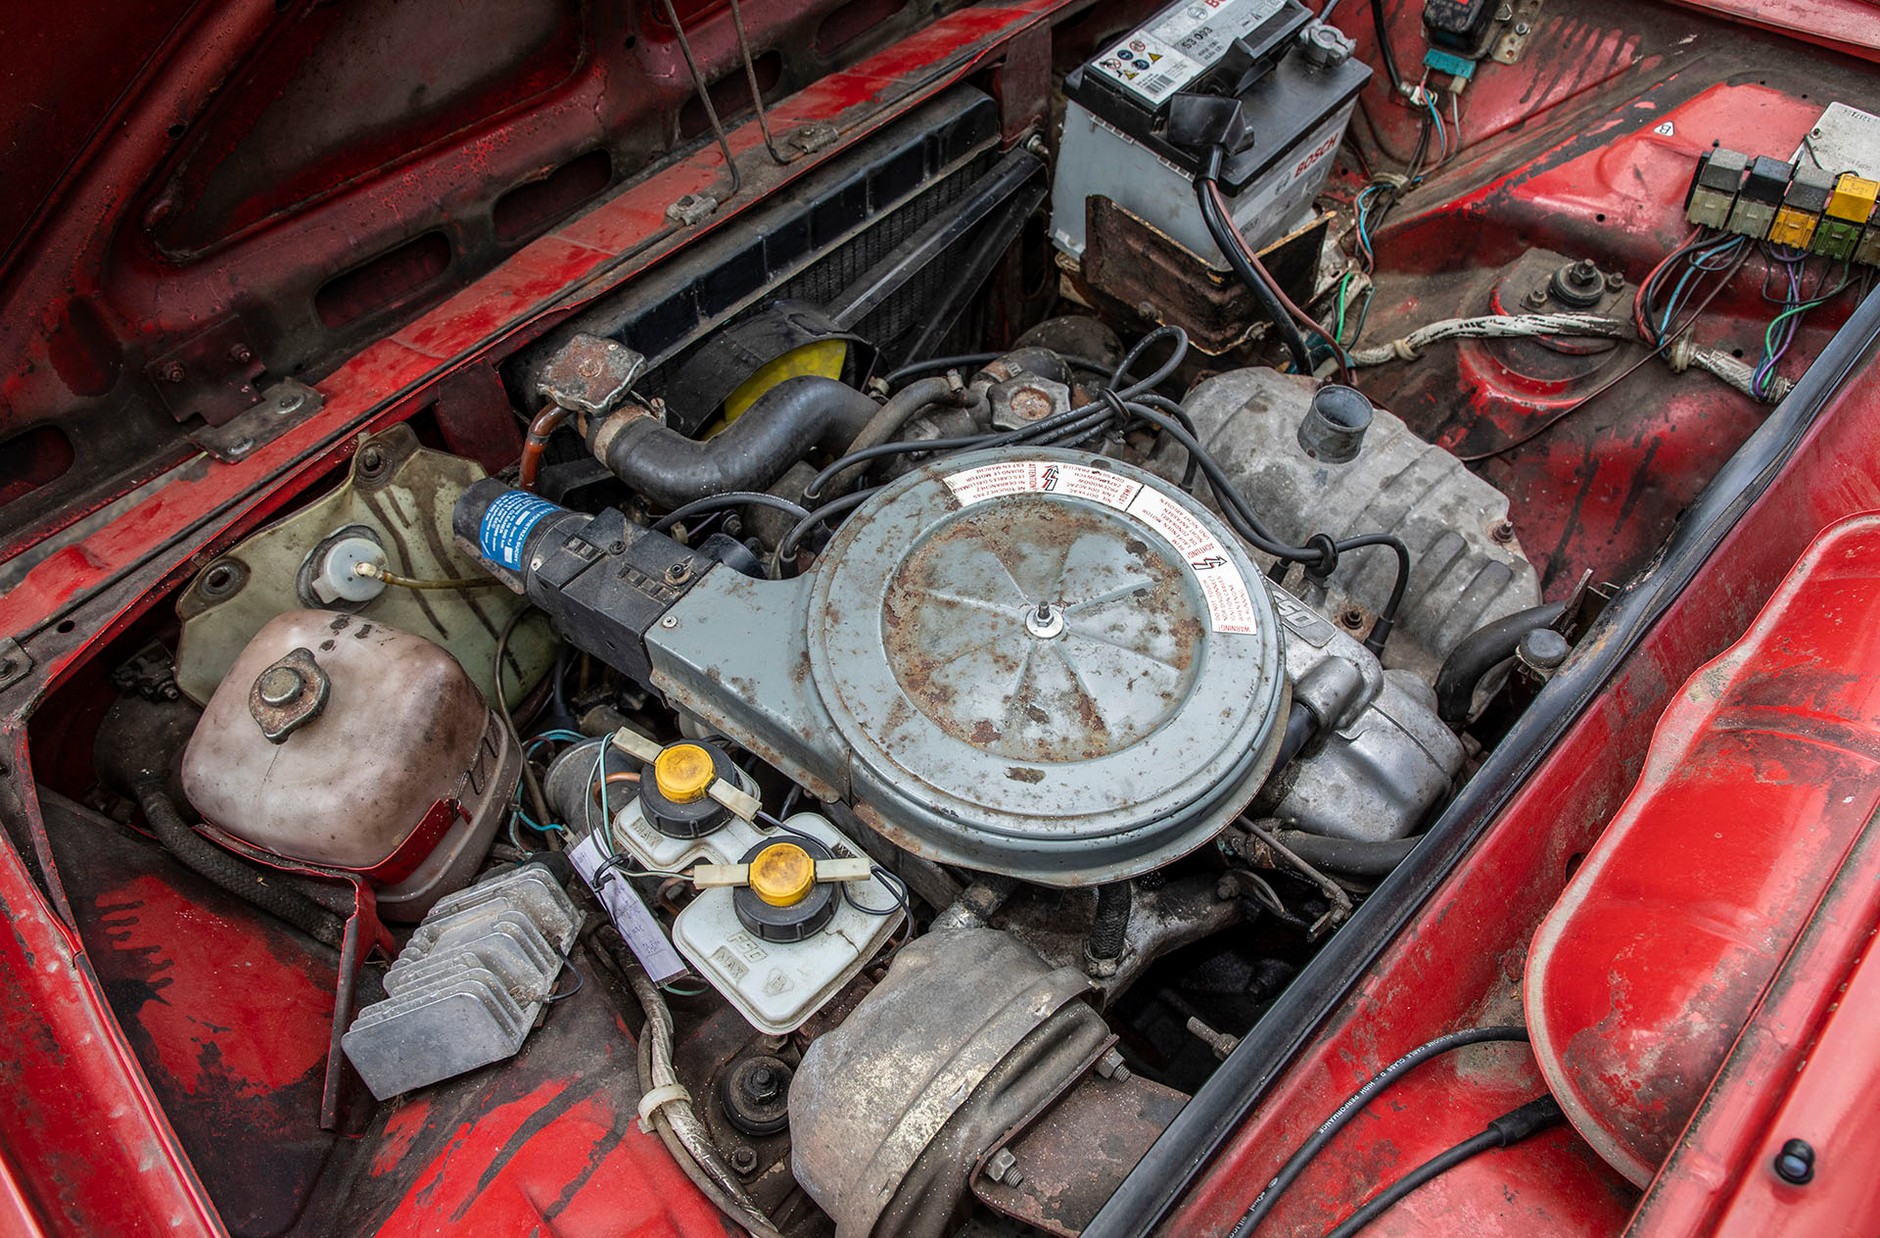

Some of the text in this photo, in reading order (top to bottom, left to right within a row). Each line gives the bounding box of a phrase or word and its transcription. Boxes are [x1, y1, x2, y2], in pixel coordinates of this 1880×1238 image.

[1295, 132, 1337, 177] BOSCH
[727, 928, 767, 962] FSO
[715, 949, 744, 979] MAX
[1386, 1057, 1406, 1072] CLASS
[1358, 1079, 1375, 1095] HIGH
[1317, 1094, 1359, 1134] PERFORMANCE
